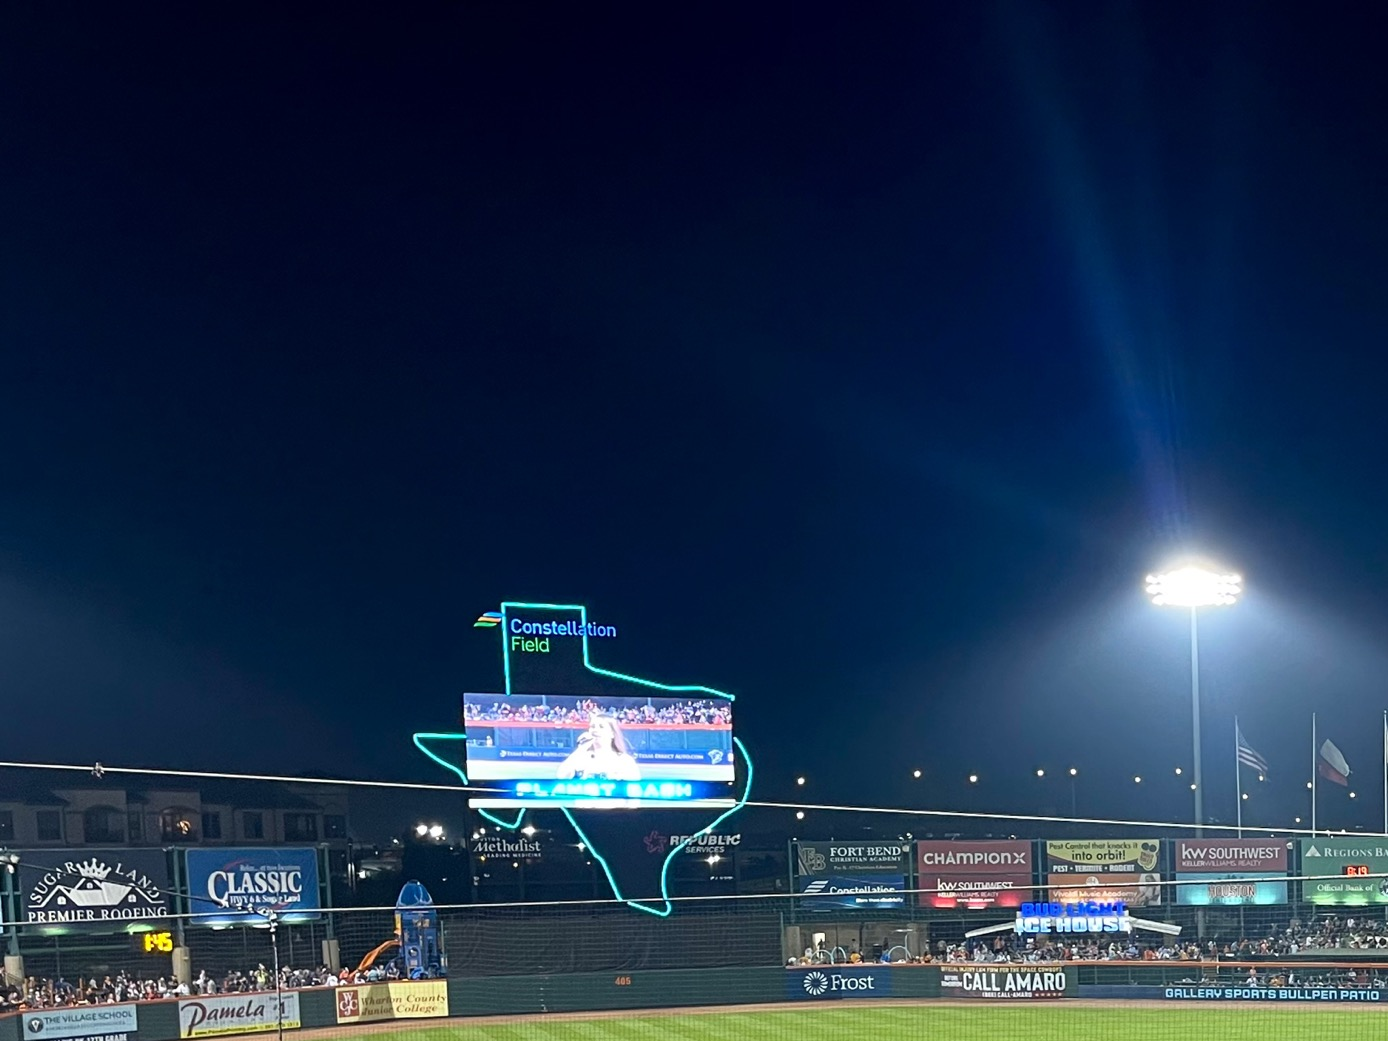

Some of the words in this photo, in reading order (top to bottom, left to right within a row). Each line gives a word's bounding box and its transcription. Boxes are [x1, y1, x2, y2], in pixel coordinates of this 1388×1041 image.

[510, 618, 616, 637] Constellation
[512, 636, 549, 652] Field
[473, 838, 541, 852] Methodist
[670, 834, 741, 846] REPUBLIC
[1049, 842, 1063, 850] Pest
[1065, 842, 1088, 850] Control
[830, 847, 865, 856] FORT
[867, 846, 901, 856] BEND
[1072, 850, 1092, 860] into
[1096, 849, 1125, 860] orbit!
[1182, 843, 1207, 859] kw
[1208, 847, 1281, 859] SOUTHWEST
[1324, 847, 1372, 857] REGIONS
[30, 861, 77, 903] SUGAR
[115, 863, 160, 898] LAND
[207, 871, 302, 908] CLASSIC
[830, 885, 896, 895] Constellation
[1207, 883, 1256, 897] HOUSTON
[1021, 903, 1062, 917] BUD
[1066, 901, 1125, 917] LIGHT
[28, 910, 94, 924] PREMIER
[1015, 917, 1051, 934] ICE
[1056, 917, 1129, 933] HOUSE
[831, 974, 875, 990] Frost
[963, 972, 1000, 991] CALL
[1005, 972, 1066, 991] AMARO
[406, 993, 446, 1004] County
[1165, 988, 1222, 998] GALLERY
[1225, 988, 1276, 999] SPORTS
[1280, 989, 1338, 1000] BULLPEN
[1340, 990, 1379, 1000] PATIO
[361, 1005, 393, 1016] Junior
[396, 1003, 438, 1014] College
[43, 1016, 61, 1025] THE
[62, 1012, 96, 1024] VILLAGE
[98, 1010, 133, 1021] SCHOOL
[181, 1000, 265, 1037] Pamela
